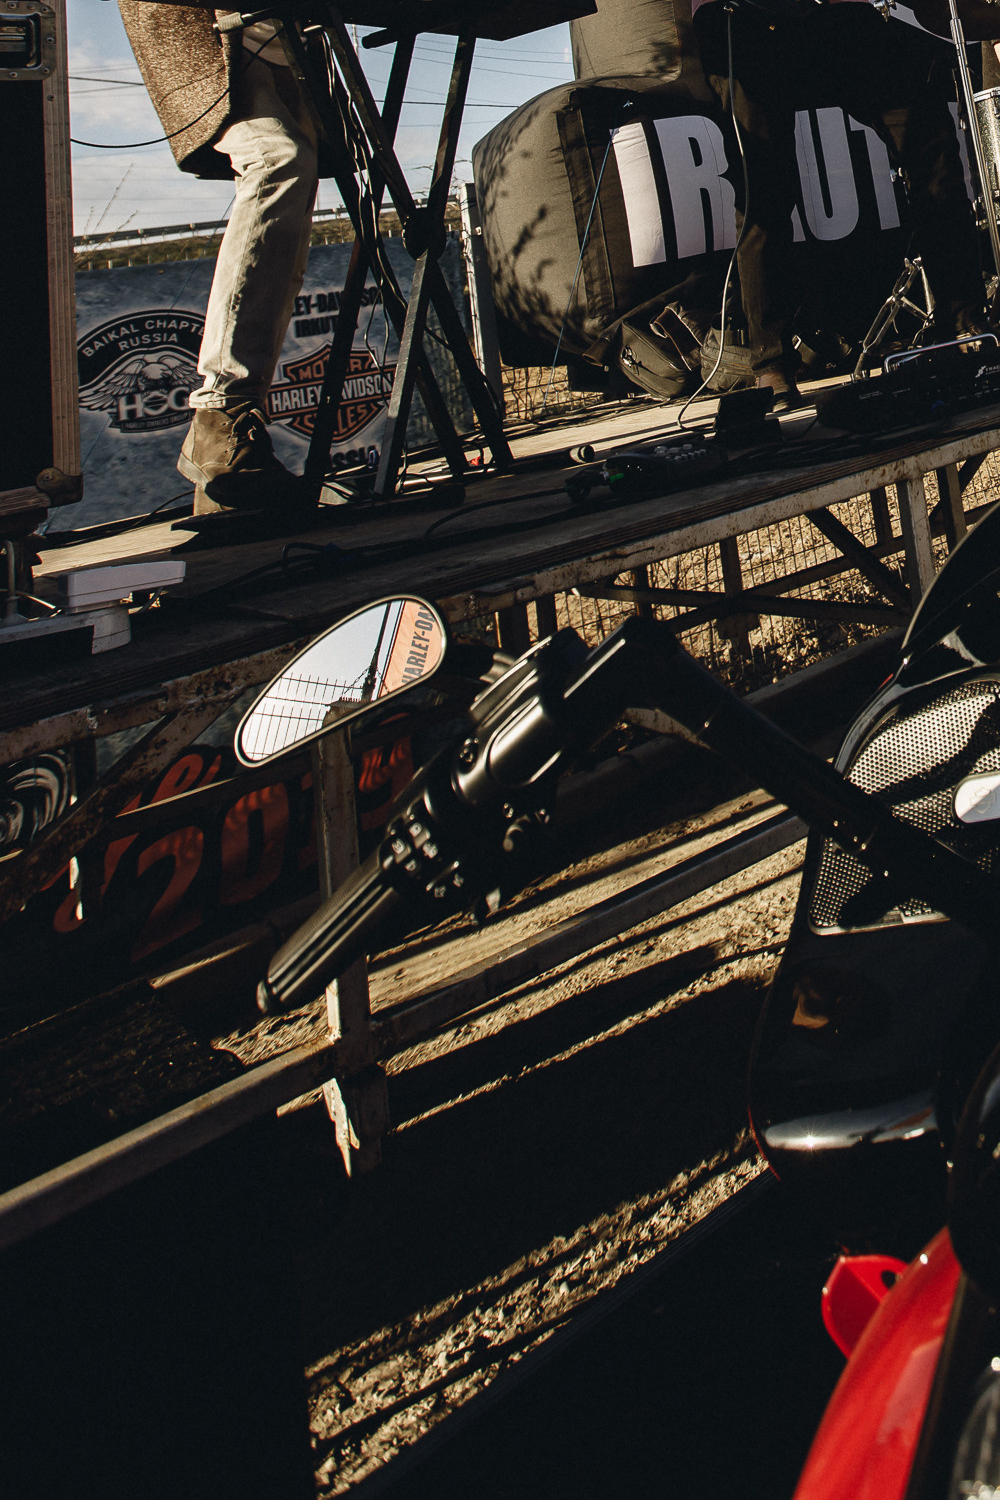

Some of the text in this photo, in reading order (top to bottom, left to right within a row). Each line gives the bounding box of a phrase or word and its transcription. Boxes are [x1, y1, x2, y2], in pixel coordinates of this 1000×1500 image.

[81, 319, 206, 357] BAIKAL CHAPTE
[117, 332, 179, 351] RUSSIA
[299, 356, 366, 382] MOR
[117, 385, 191, 422] HOG
[270, 372, 393, 413] HARLEYAVIDSON
[303, 402, 368, 435] CLES
